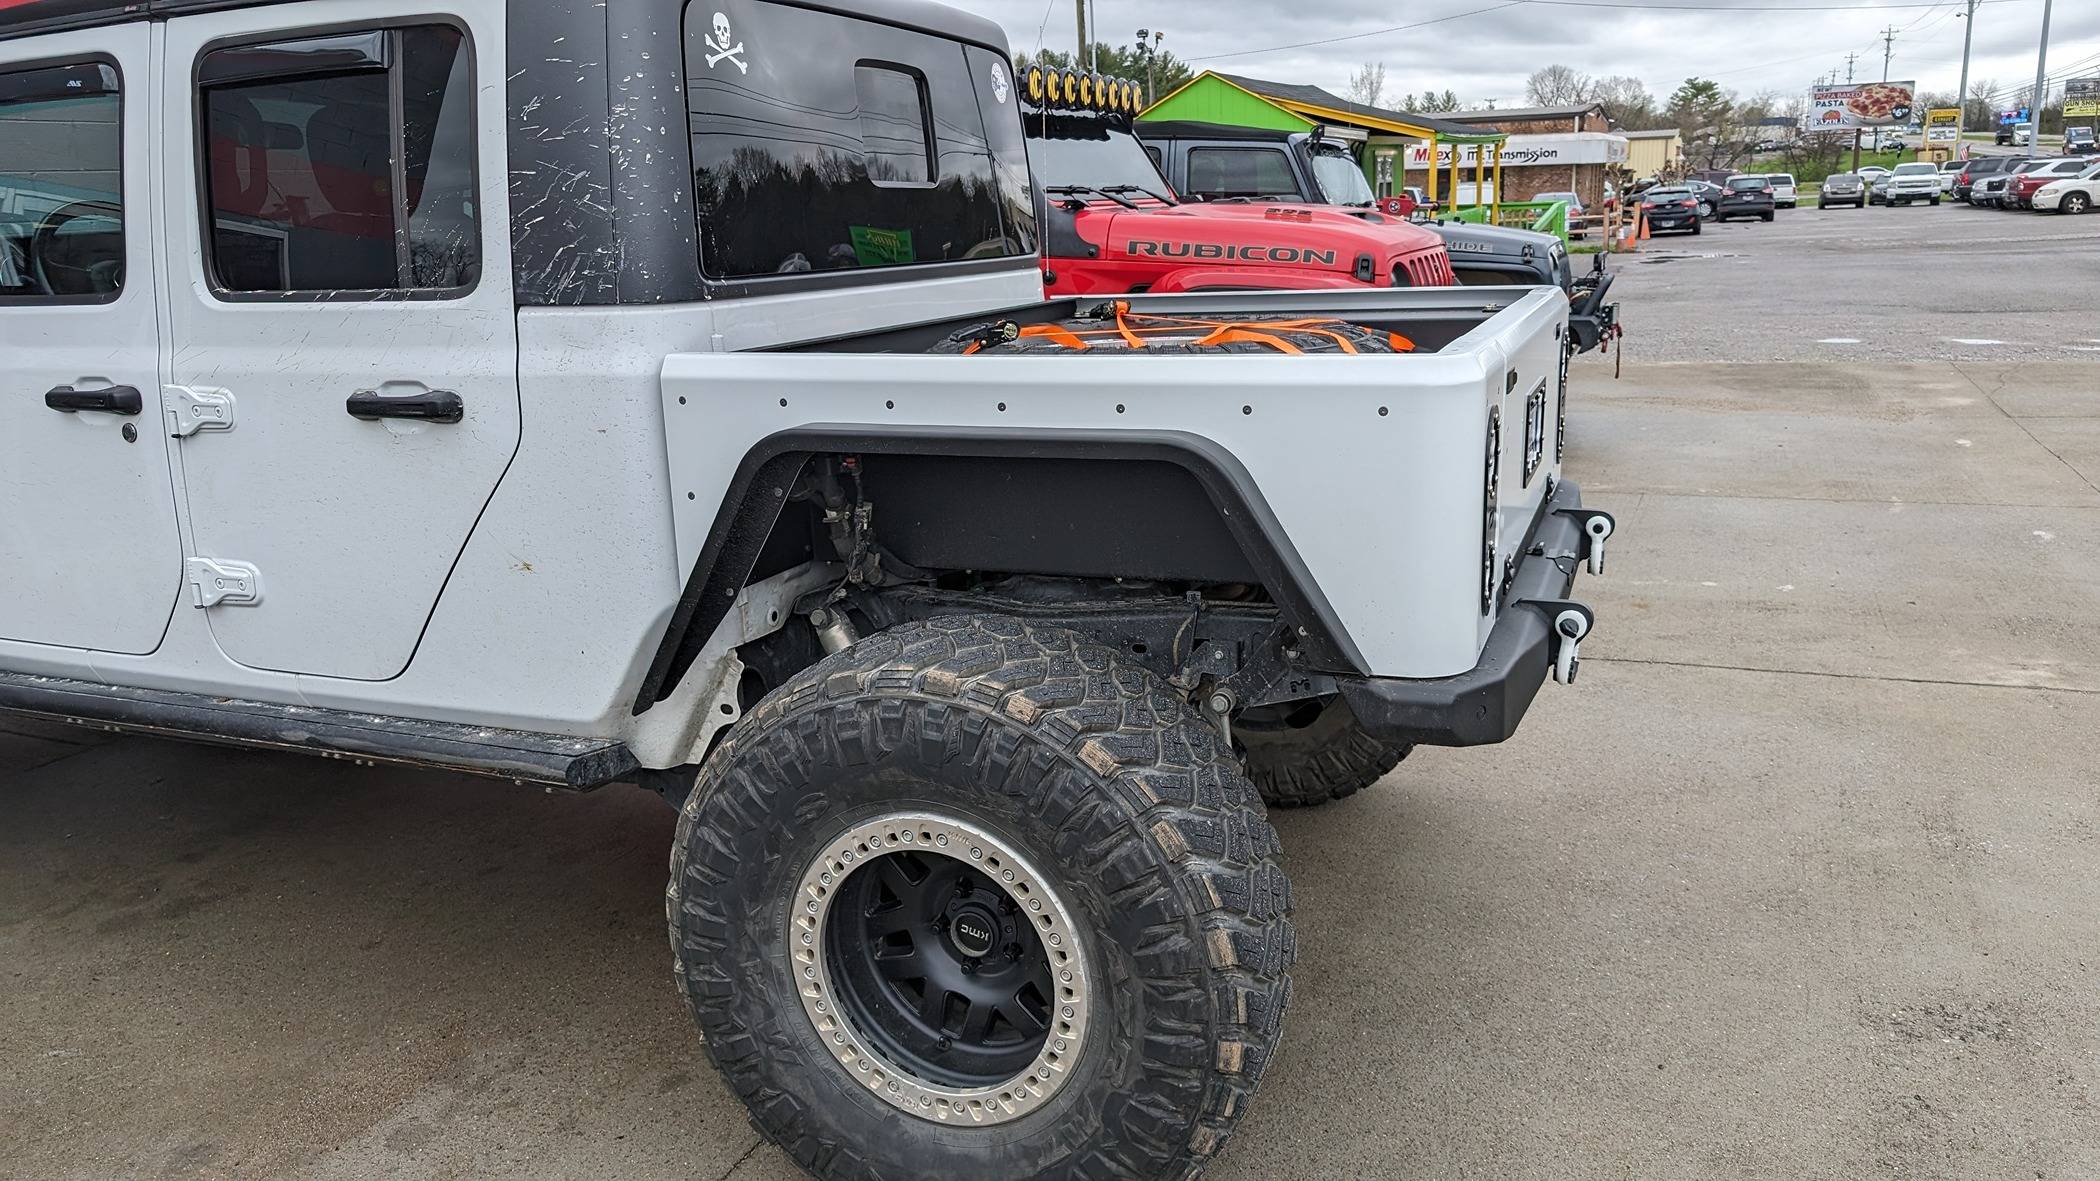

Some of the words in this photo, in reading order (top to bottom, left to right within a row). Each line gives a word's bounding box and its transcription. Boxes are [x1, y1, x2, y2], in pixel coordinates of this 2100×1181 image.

[1029, 68, 1042, 101] KC
[1047, 71, 1059, 102] KC
[1064, 73, 1075, 103] KC
[1080, 76, 1091, 106] KC
[1095, 78, 1105, 107] KC
[1108, 80, 1118, 109] KC
[1486, 148, 1558, 163] Tansmission
[1127, 240, 1336, 265] RUBICON
